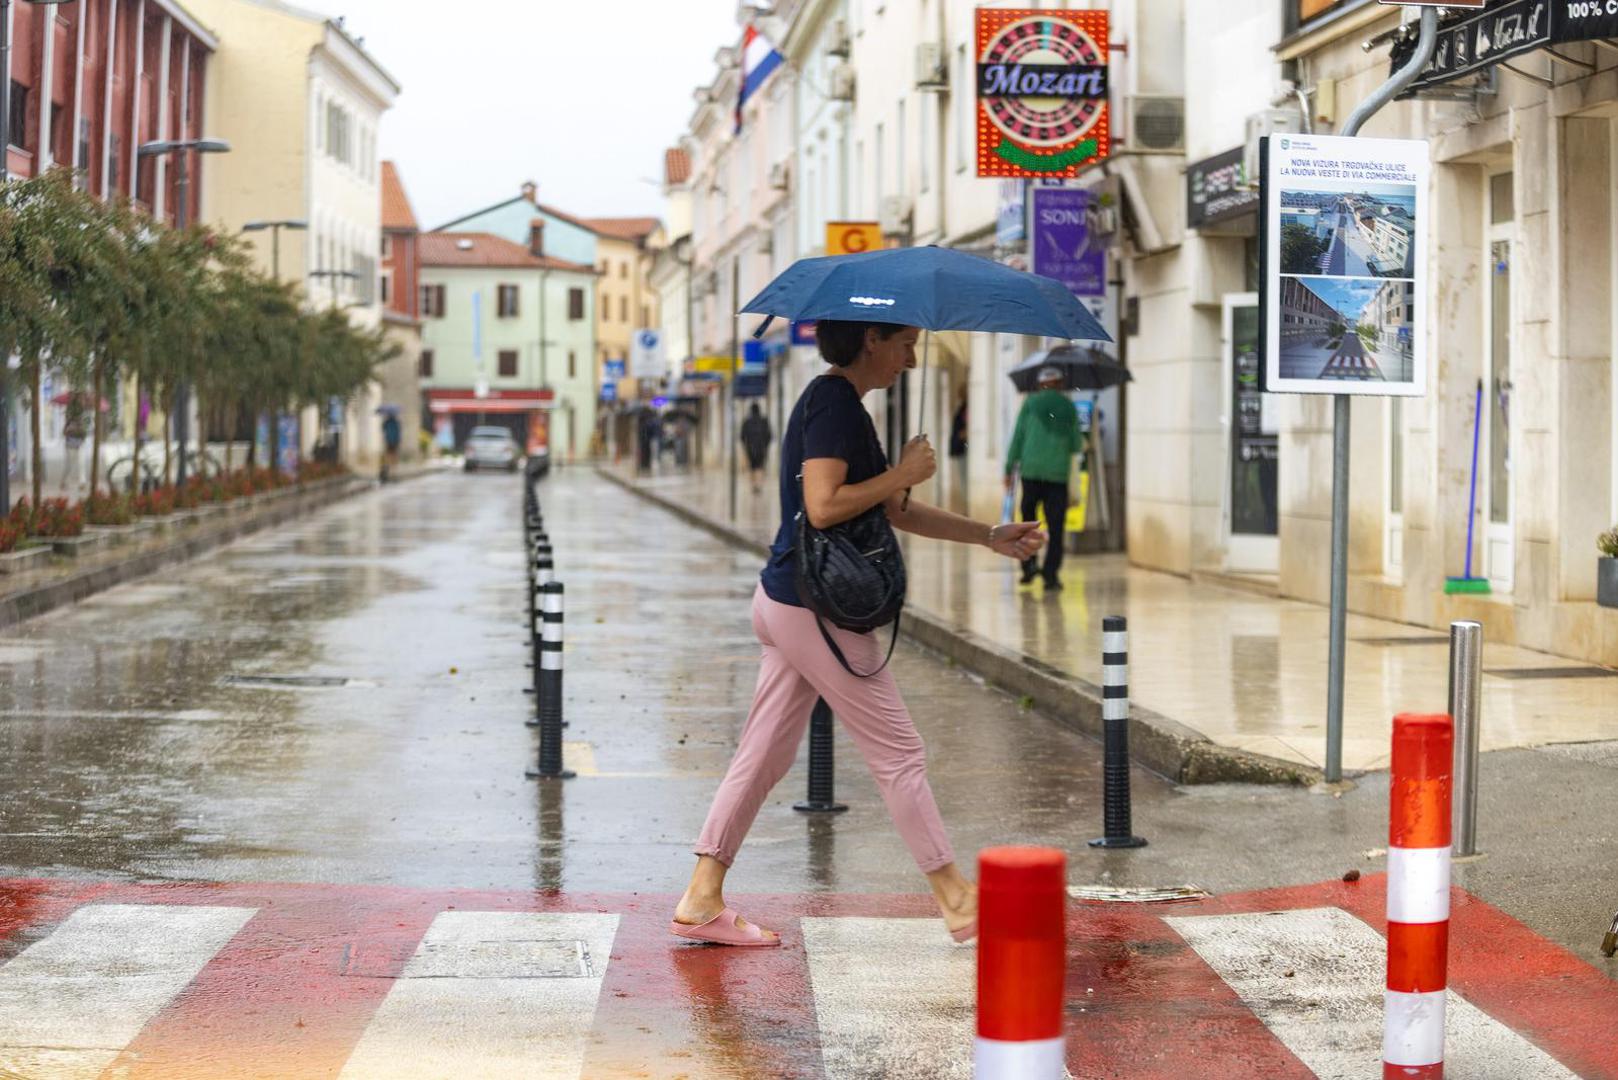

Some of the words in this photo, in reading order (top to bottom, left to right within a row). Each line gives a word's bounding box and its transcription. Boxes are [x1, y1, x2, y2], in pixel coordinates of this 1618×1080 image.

[1567, 1, 1602, 19] 100%
[983, 63, 1105, 96] Mozart
[1280, 167, 1290, 175] LA
[1291, 168, 1316, 177] NUOVA
[1318, 169, 1341, 178] VESTE
[1343, 170, 1350, 178] DI
[1352, 170, 1364, 179] VIA
[1365, 171, 1416, 182] COMMERCIALE
[1291, 159, 1310, 168] NOVA
[1313, 160, 1339, 168] VIZURA
[1385, 163, 1407, 172] ULICE
[841, 228, 869, 253] G
